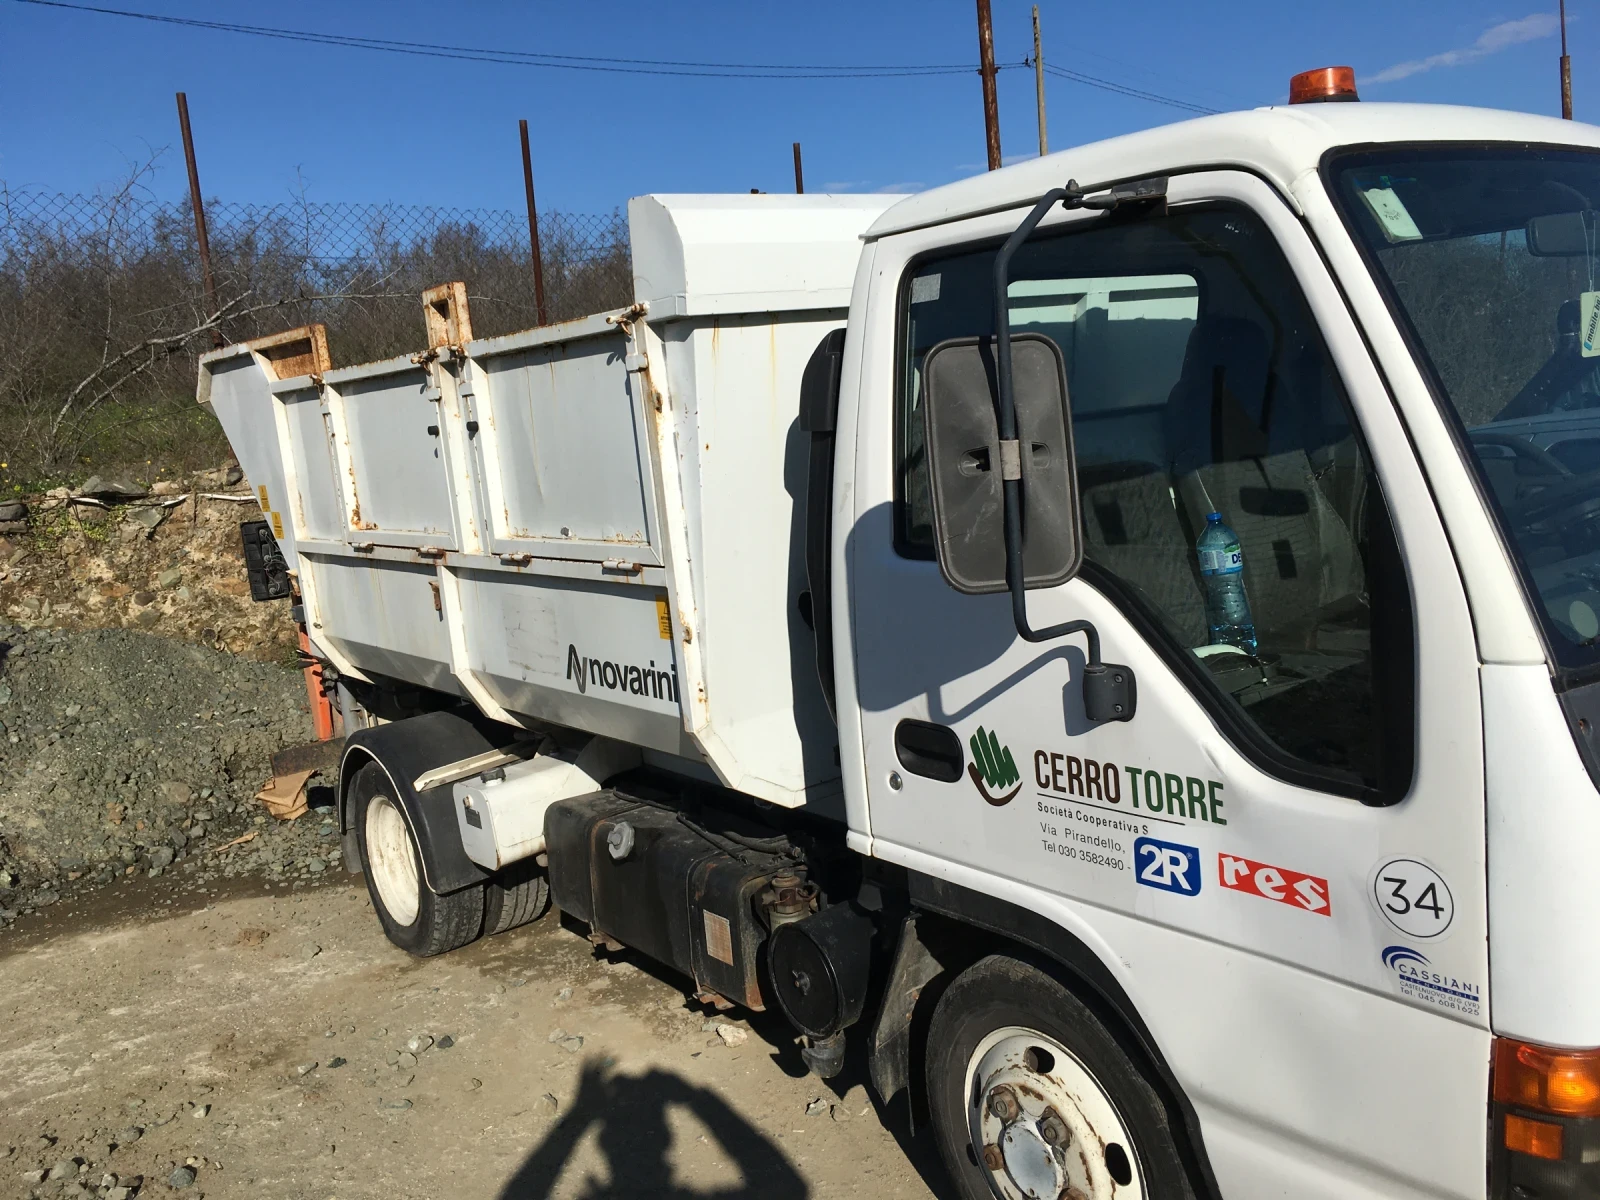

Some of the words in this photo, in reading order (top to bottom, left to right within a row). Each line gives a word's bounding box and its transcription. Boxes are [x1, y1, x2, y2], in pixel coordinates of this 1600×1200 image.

[589, 659, 679, 704] novarini
[1034, 749, 1121, 804] CERRO
[1125, 766, 1227, 826] TORRE
[1037, 801, 1073, 819] Società
[1076, 810, 1139, 834] Cooperativa
[1040, 822, 1057, 836] Via
[1064, 827, 1126, 854] Pirandello,
[1042, 840, 1056, 853] Tel
[1058, 844, 1077, 859] 030
[1079, 849, 1124, 871] 3582490
[1221, 856, 1327, 911] res
[1383, 876, 1445, 920] 34
[1398, 963, 1479, 995] CASSIANI
[1400, 980, 1447, 1000] CASTELNUOVO
[1464, 1000, 1480, 1010] (VR)
[1418, 992, 1436, 1003] 045
[1438, 999, 1480, 1017] 6081625
